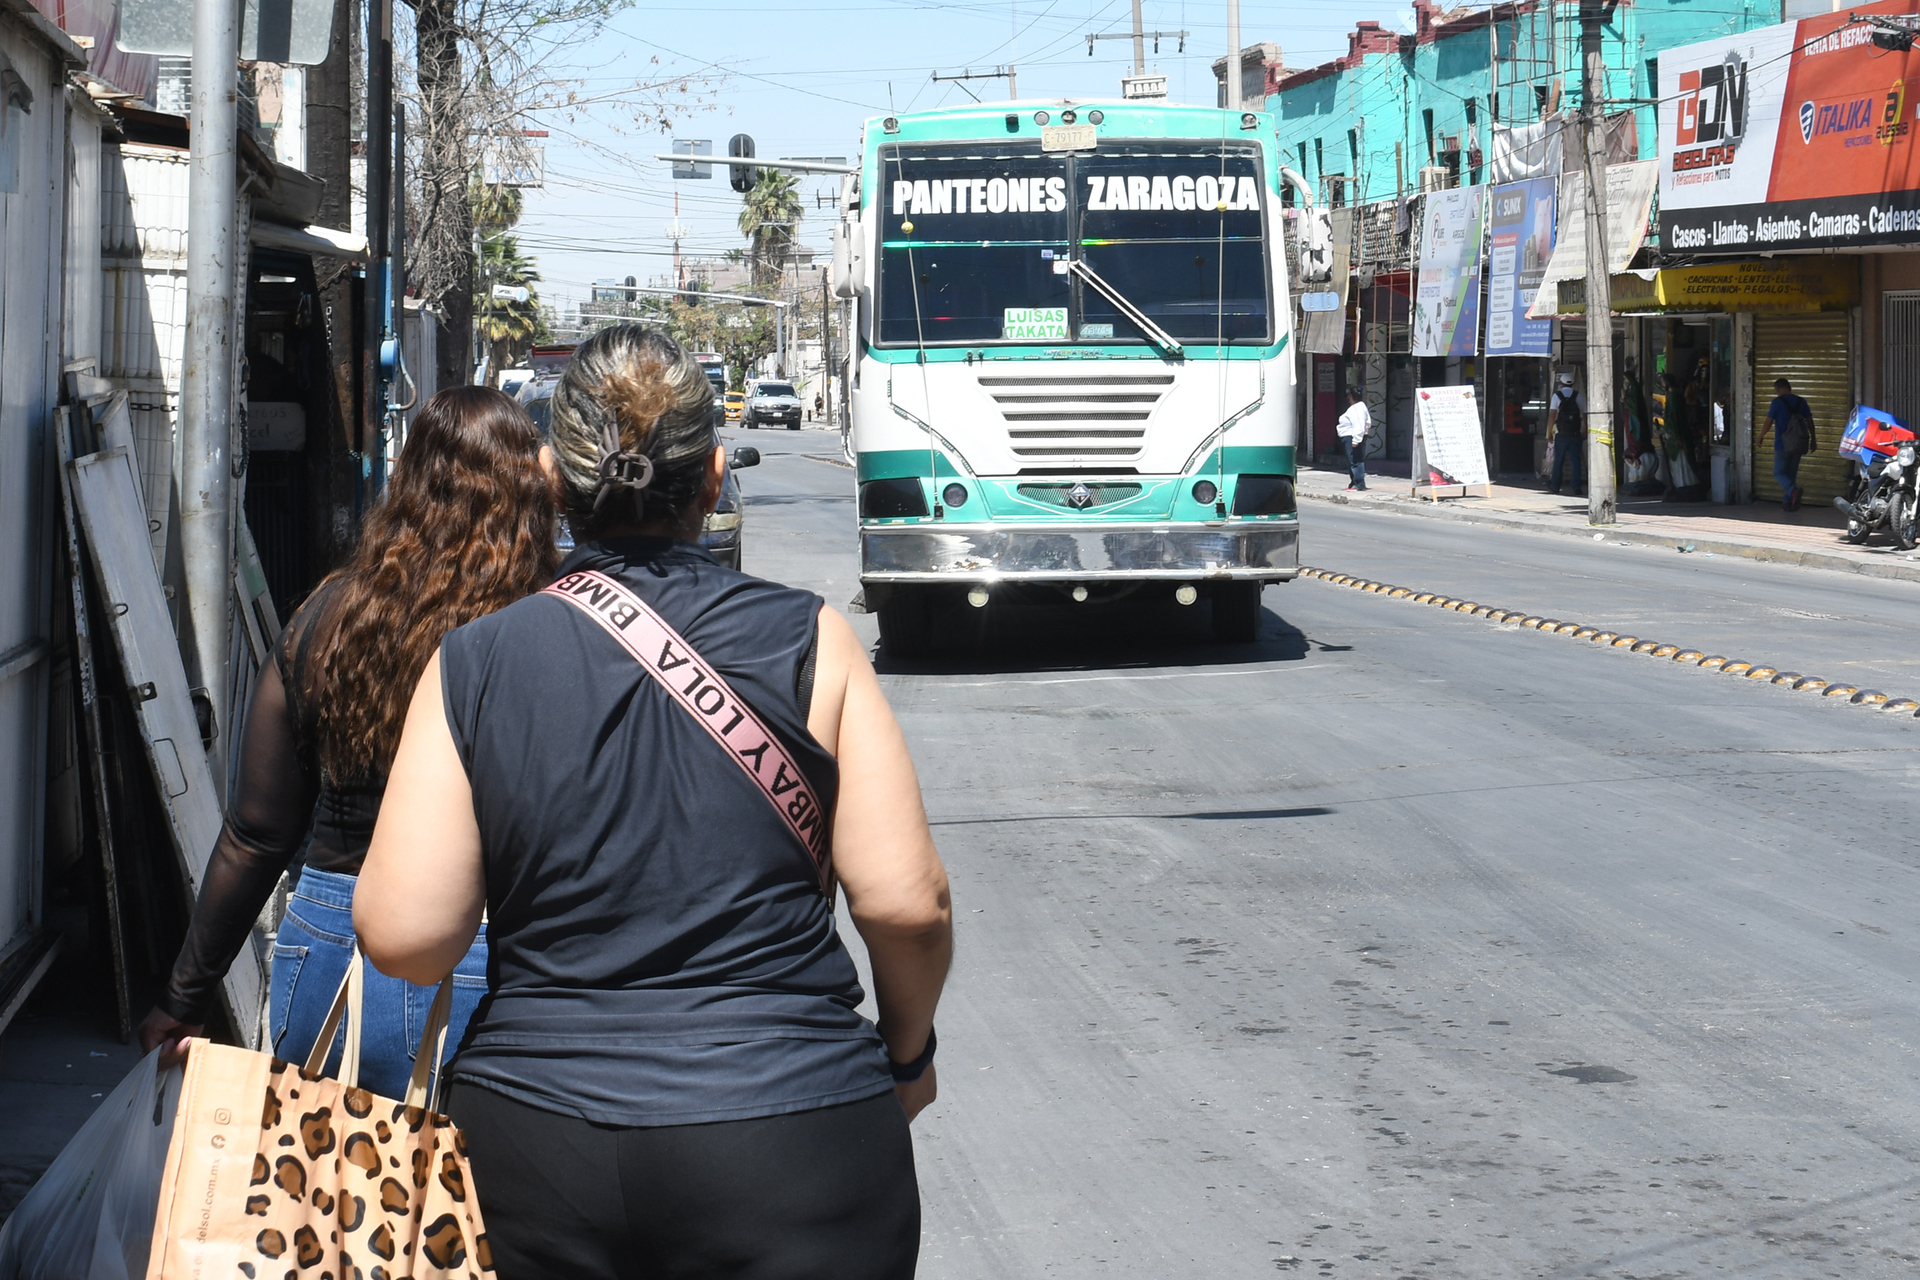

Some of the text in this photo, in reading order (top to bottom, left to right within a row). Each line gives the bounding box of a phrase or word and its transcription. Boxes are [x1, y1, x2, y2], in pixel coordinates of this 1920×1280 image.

[1829, 32, 1840, 51] DE
[1676, 61, 1748, 146] BDN
[1815, 98, 1872, 136] ITALIKA
[1672, 144, 1736, 172] BICICLETAS
[893, 175, 1261, 215] PANTEONES ZARAGOZA
[1672, 205, 1920, 248] Cascos Llantas Asientos Camaras Cadenas
[1006, 325, 1065, 338] TAKATA
[1007, 309, 1064, 323] LUISAS
[657, 639, 745, 737] LOLA
[739, 740, 771, 774] Y
